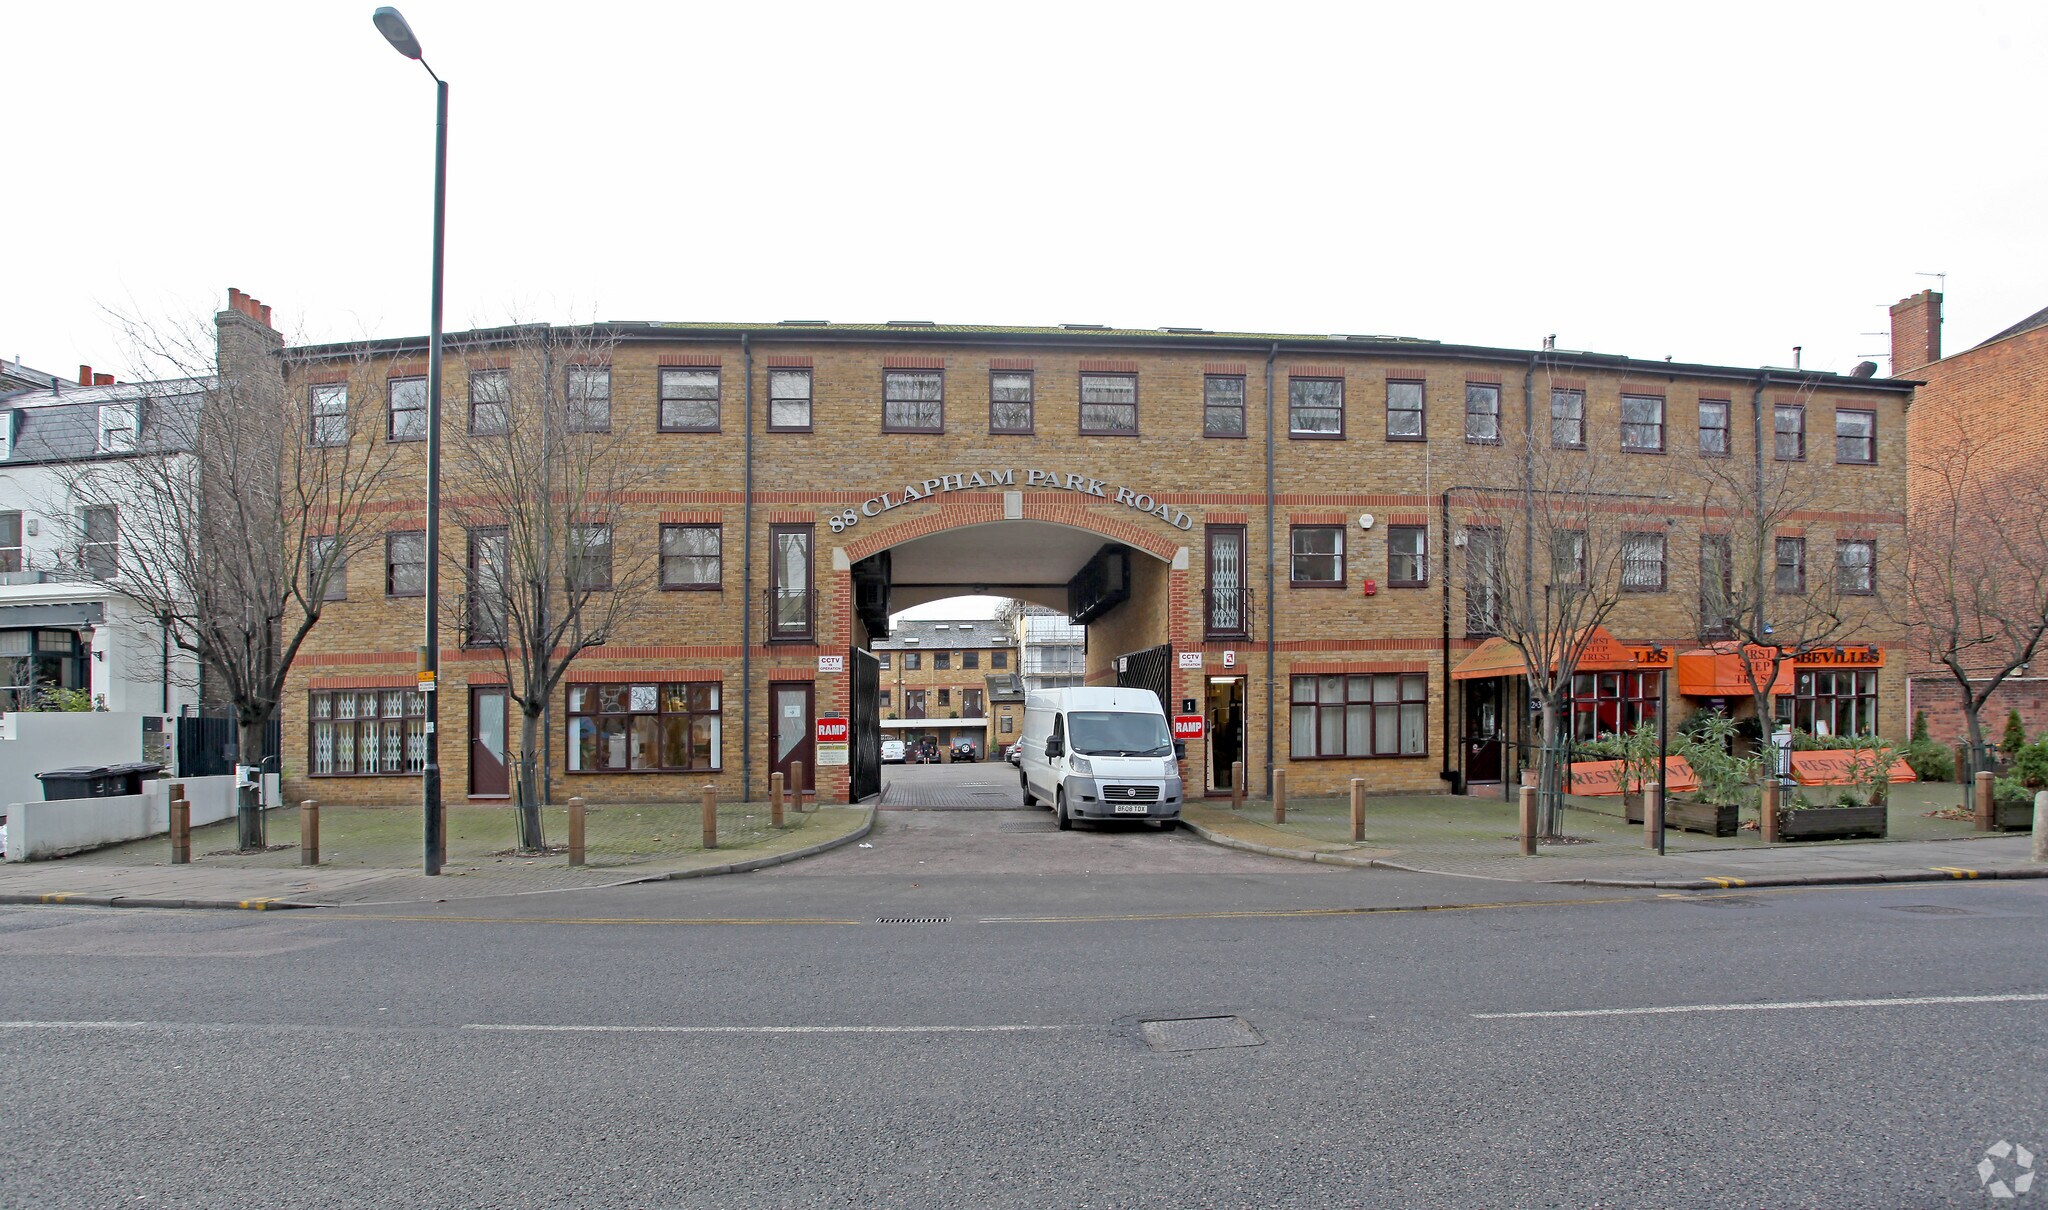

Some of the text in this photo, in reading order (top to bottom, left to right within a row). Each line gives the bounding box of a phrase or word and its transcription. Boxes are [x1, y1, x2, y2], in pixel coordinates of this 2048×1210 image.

[828, 468, 1194, 534] 88 CLAPHAM PARK ROAD
[1583, 653, 1611, 661] TRUST
[1187, 701, 1192, 711] 1
[818, 725, 846, 736] RAMP
[1175, 722, 1202, 733] RAMP
